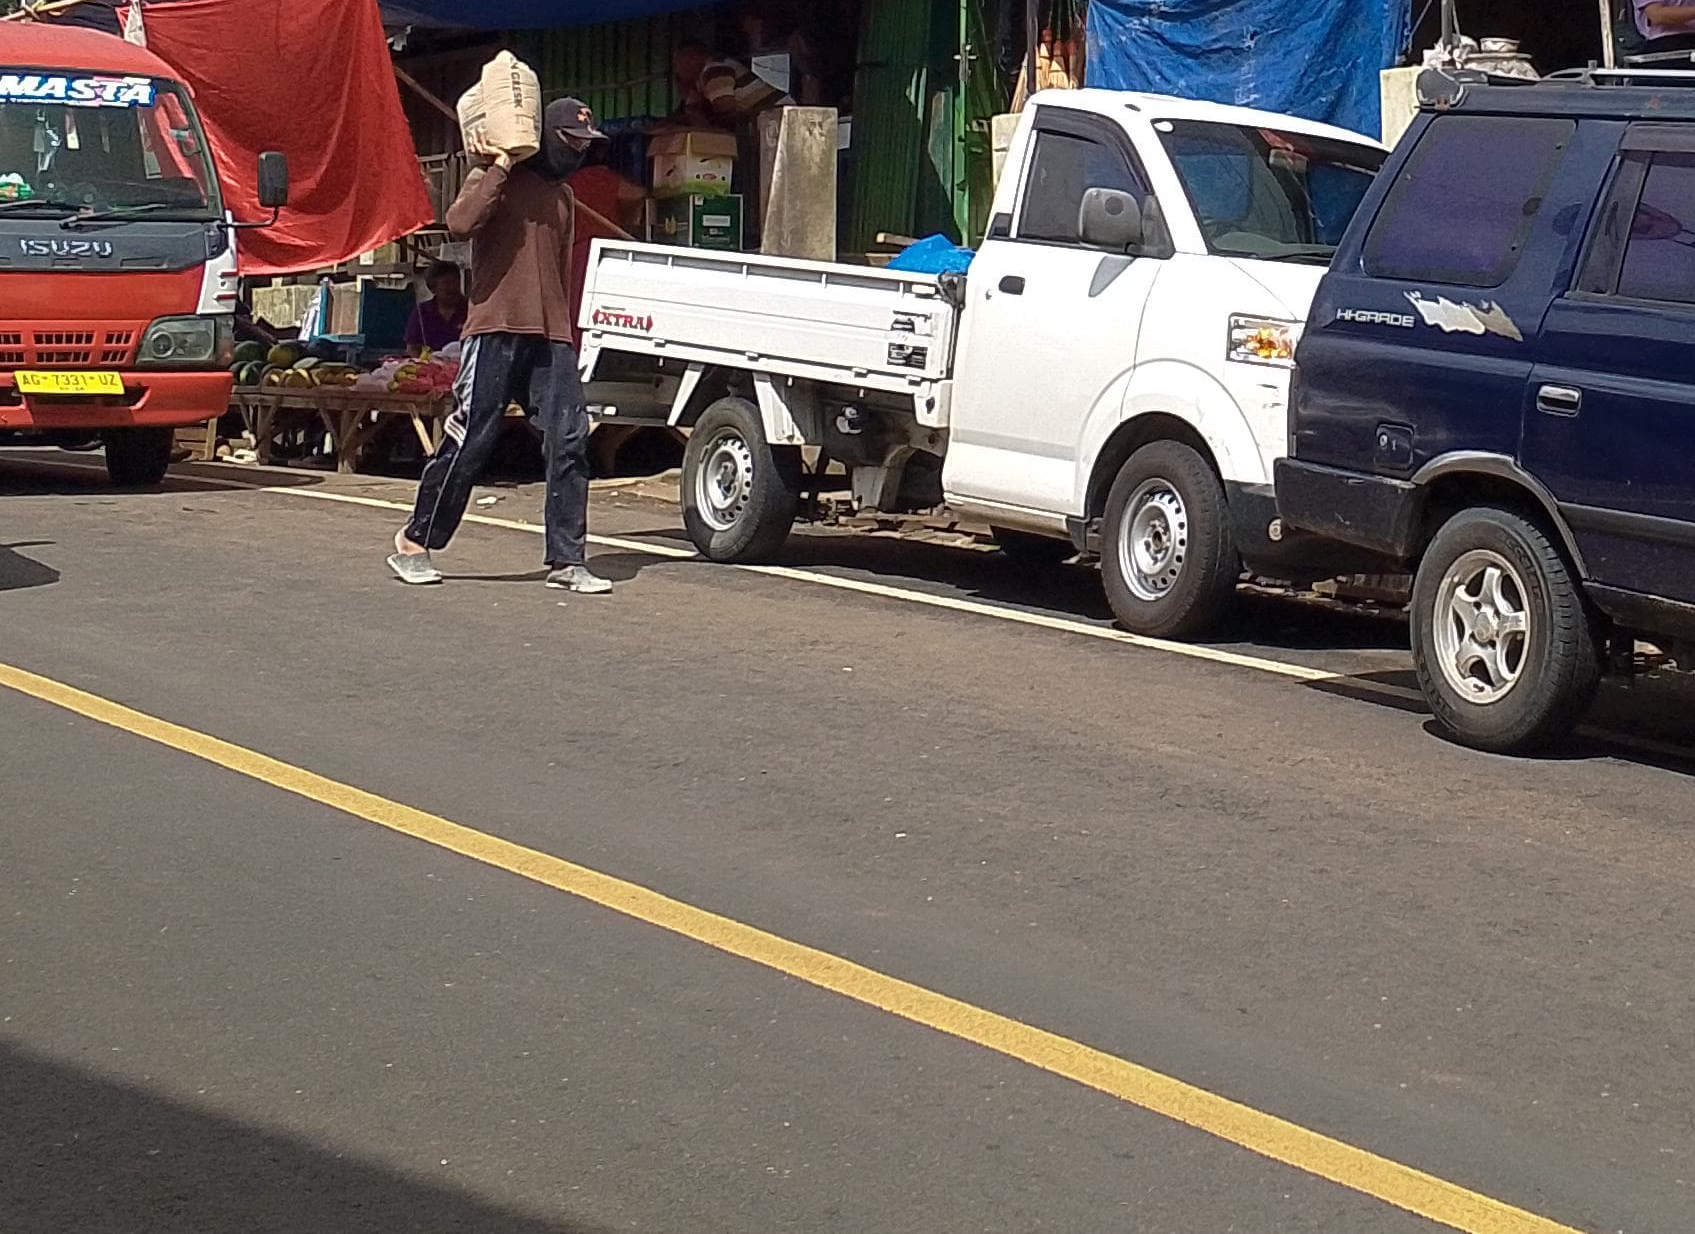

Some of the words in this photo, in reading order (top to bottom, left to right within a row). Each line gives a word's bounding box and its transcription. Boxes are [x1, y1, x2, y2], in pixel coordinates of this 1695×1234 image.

[20, 238, 112, 256] ISUZU
[22, 373, 41, 386] AG
[51, 373, 88, 387] 7331
[98, 374, 119, 387] UZ
